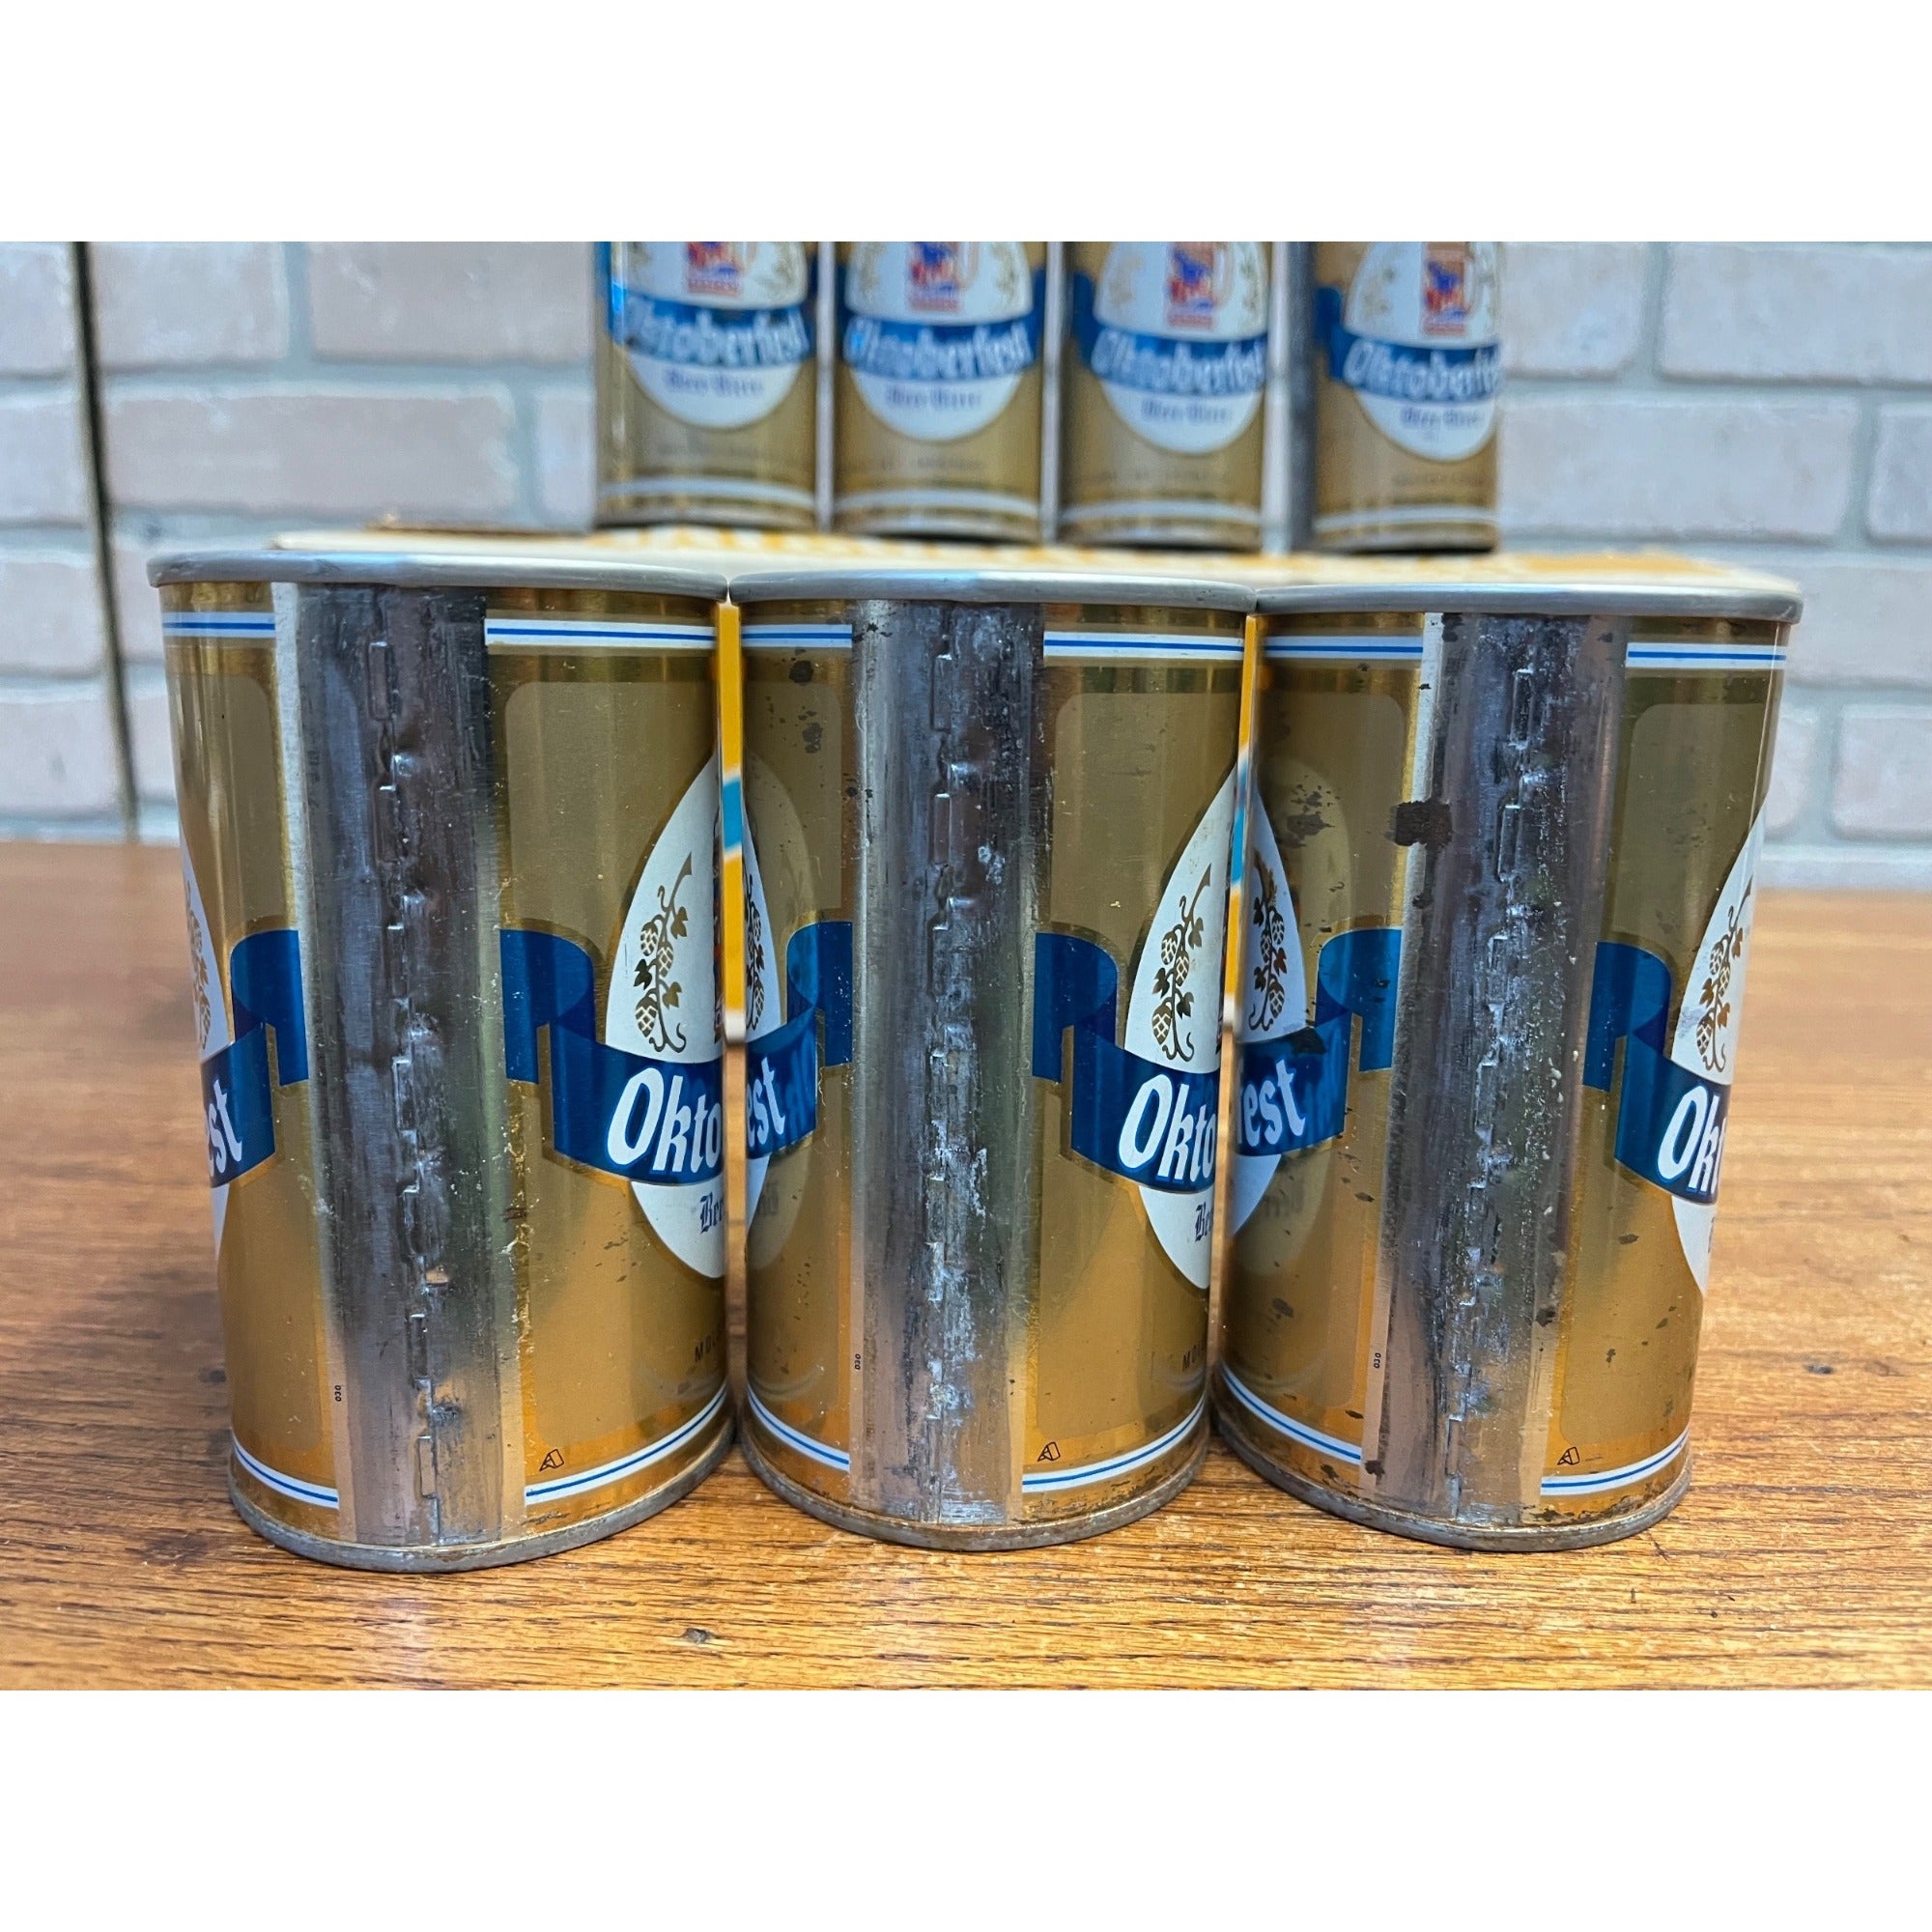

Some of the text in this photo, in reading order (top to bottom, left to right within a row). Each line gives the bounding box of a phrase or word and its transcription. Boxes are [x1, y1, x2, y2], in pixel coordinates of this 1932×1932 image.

[207, 1078, 242, 1177] st
[607, 1066, 722, 1174] Okto
[1118, 1073, 1217, 1182] Okto
[1373, 1352, 1381, 1369] 030
